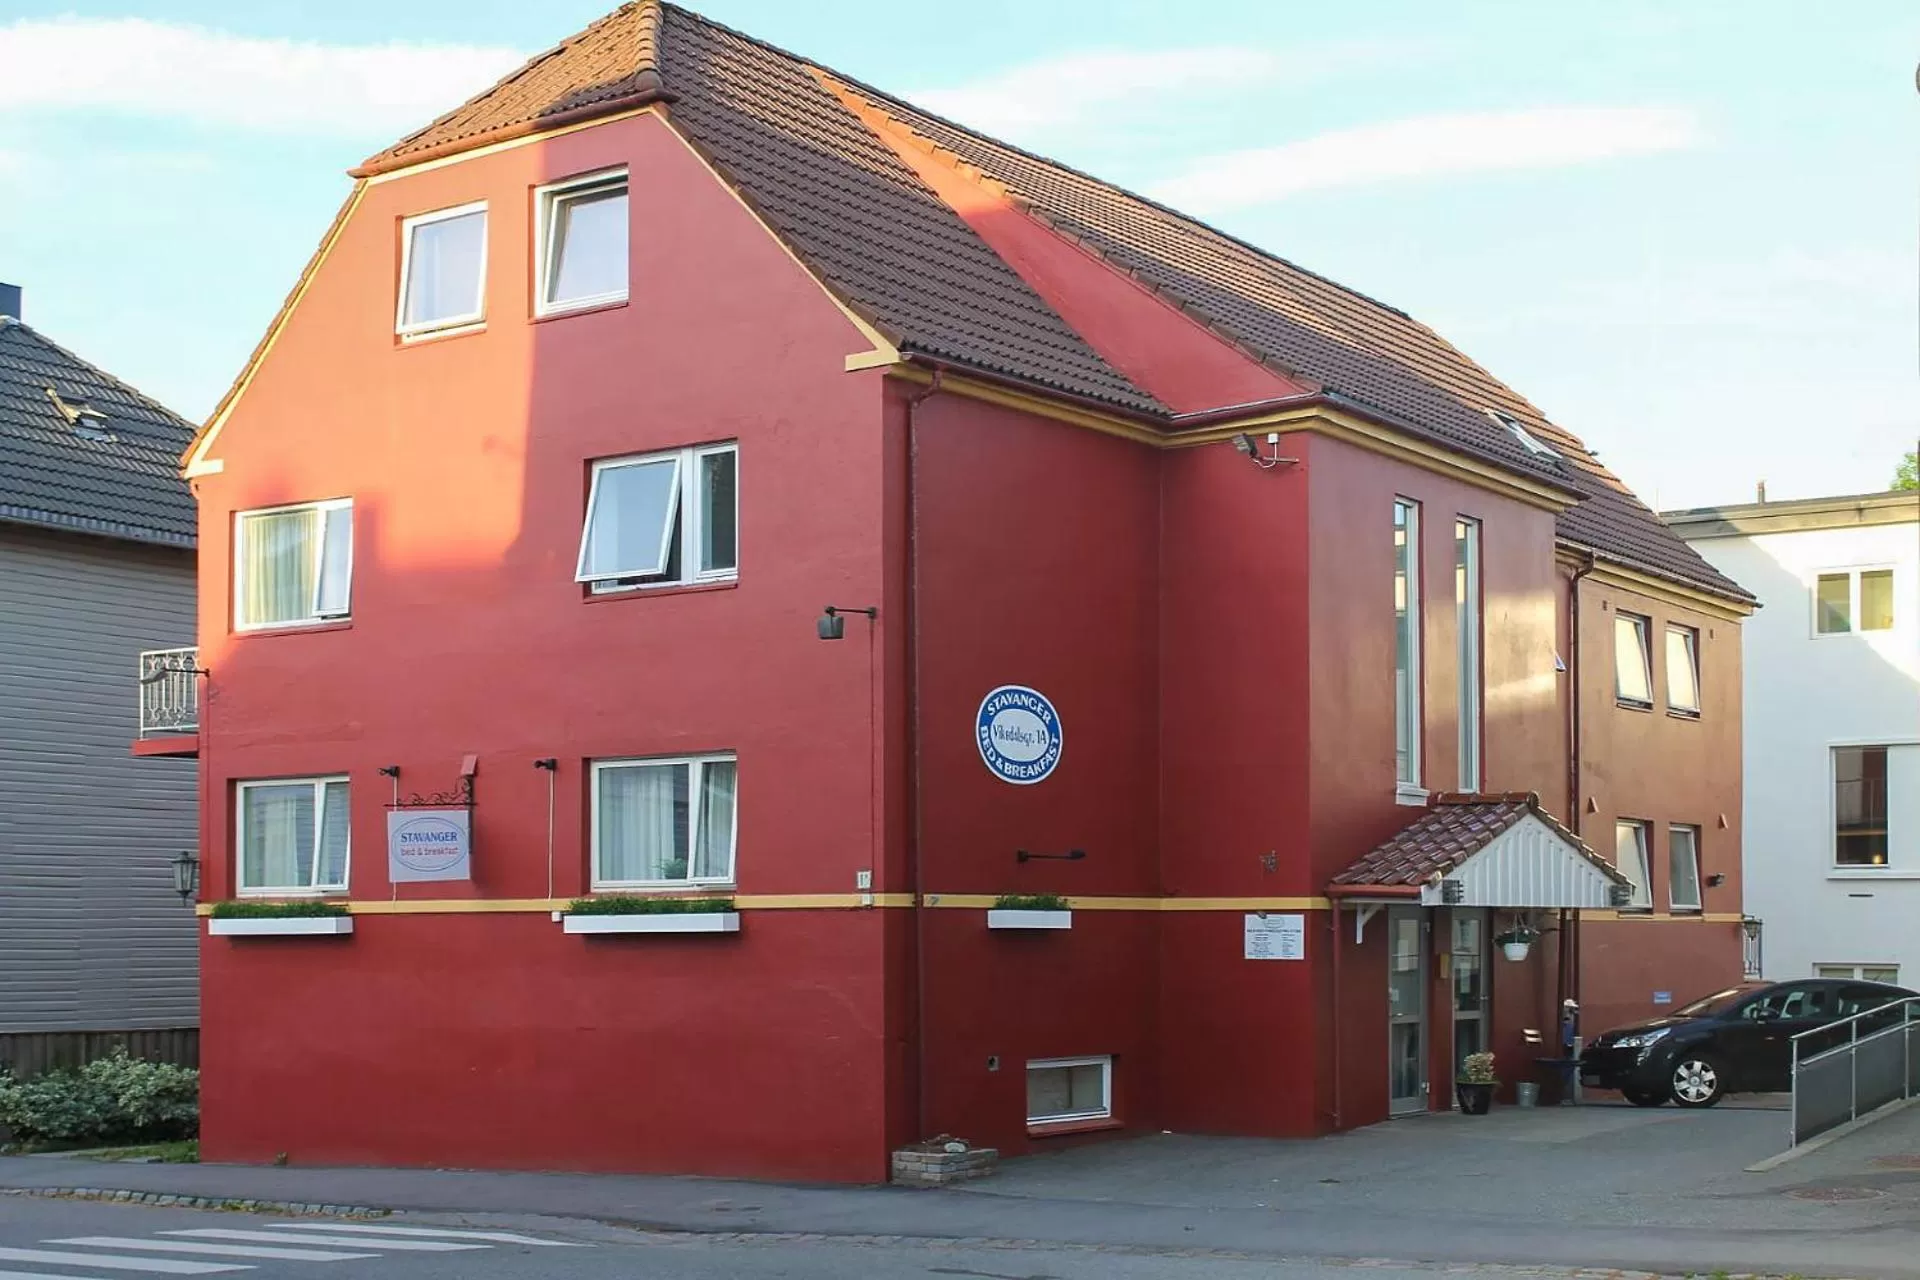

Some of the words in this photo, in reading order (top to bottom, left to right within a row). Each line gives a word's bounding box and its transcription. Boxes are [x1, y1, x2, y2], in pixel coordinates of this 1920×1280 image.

[987, 693, 1051, 724] STAVANGER
[981, 725, 997, 762] BED
[996, 758, 1004, 770] &
[1004, 733, 1059, 778] BREAKFAST
[400, 831, 458, 843] STAVANGER
